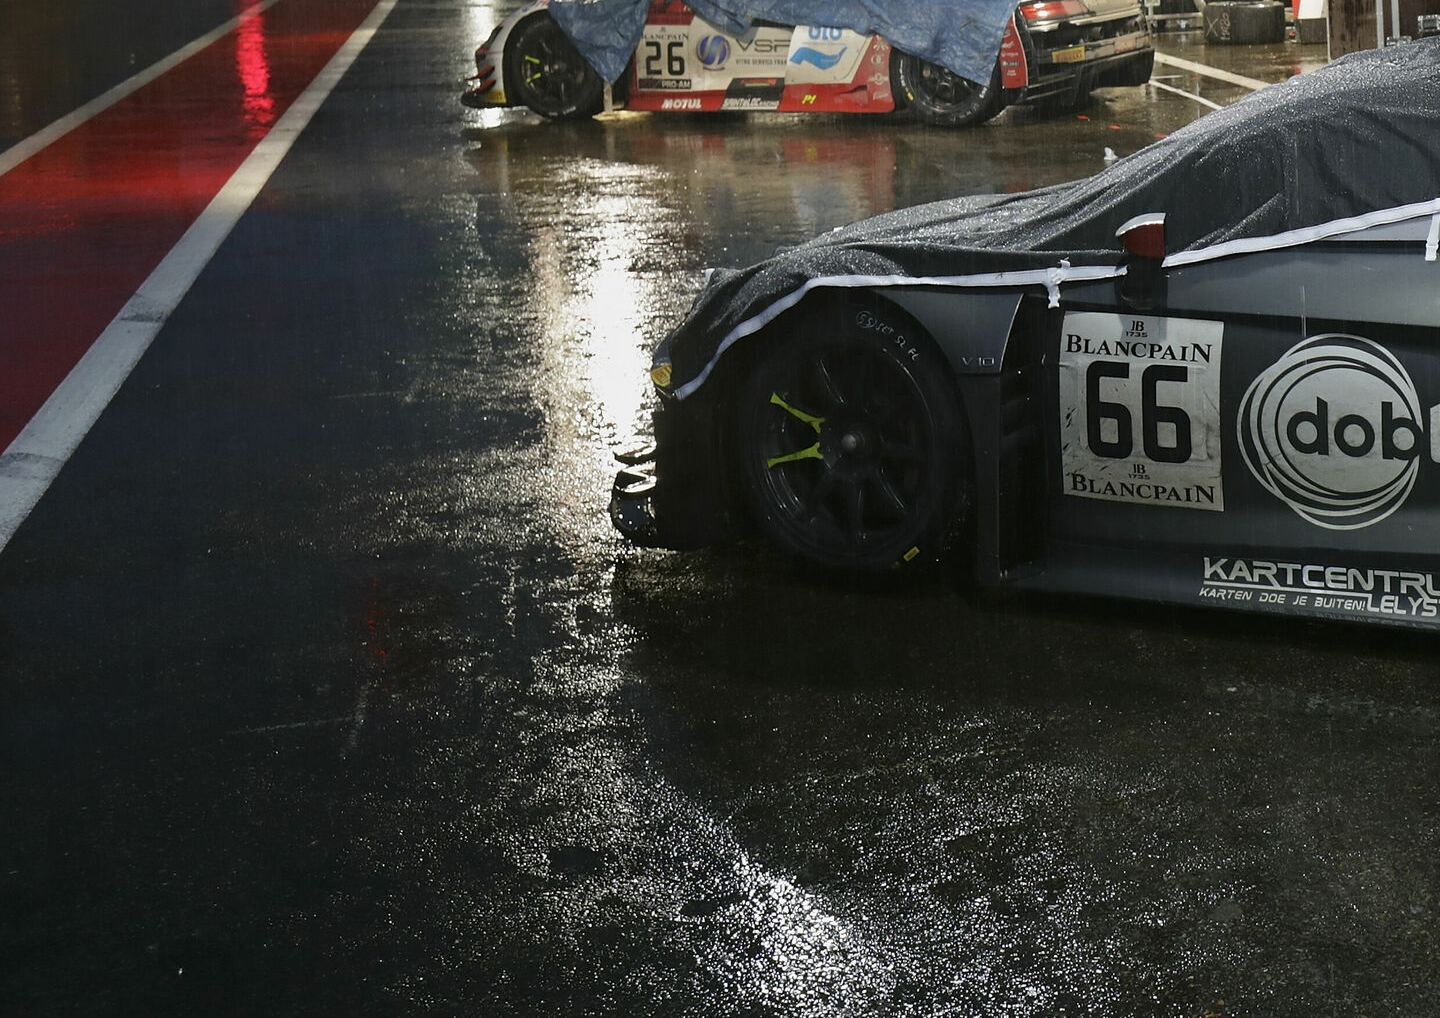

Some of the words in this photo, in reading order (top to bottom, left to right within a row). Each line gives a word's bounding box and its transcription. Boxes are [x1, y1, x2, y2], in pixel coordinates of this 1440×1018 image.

[646, 41, 685, 76] 26
[662, 99, 702, 109] MOTUL
[1065, 334, 1213, 363] BLANCPAIN
[1086, 360, 1192, 464] 66
[1072, 473, 1215, 504] BLANCPAIN
[1199, 587, 1253, 600] KARTEN
[1258, 592, 1286, 603] DOE
[1293, 595, 1307, 606] JE
[1314, 597, 1366, 611] BUITEN!
